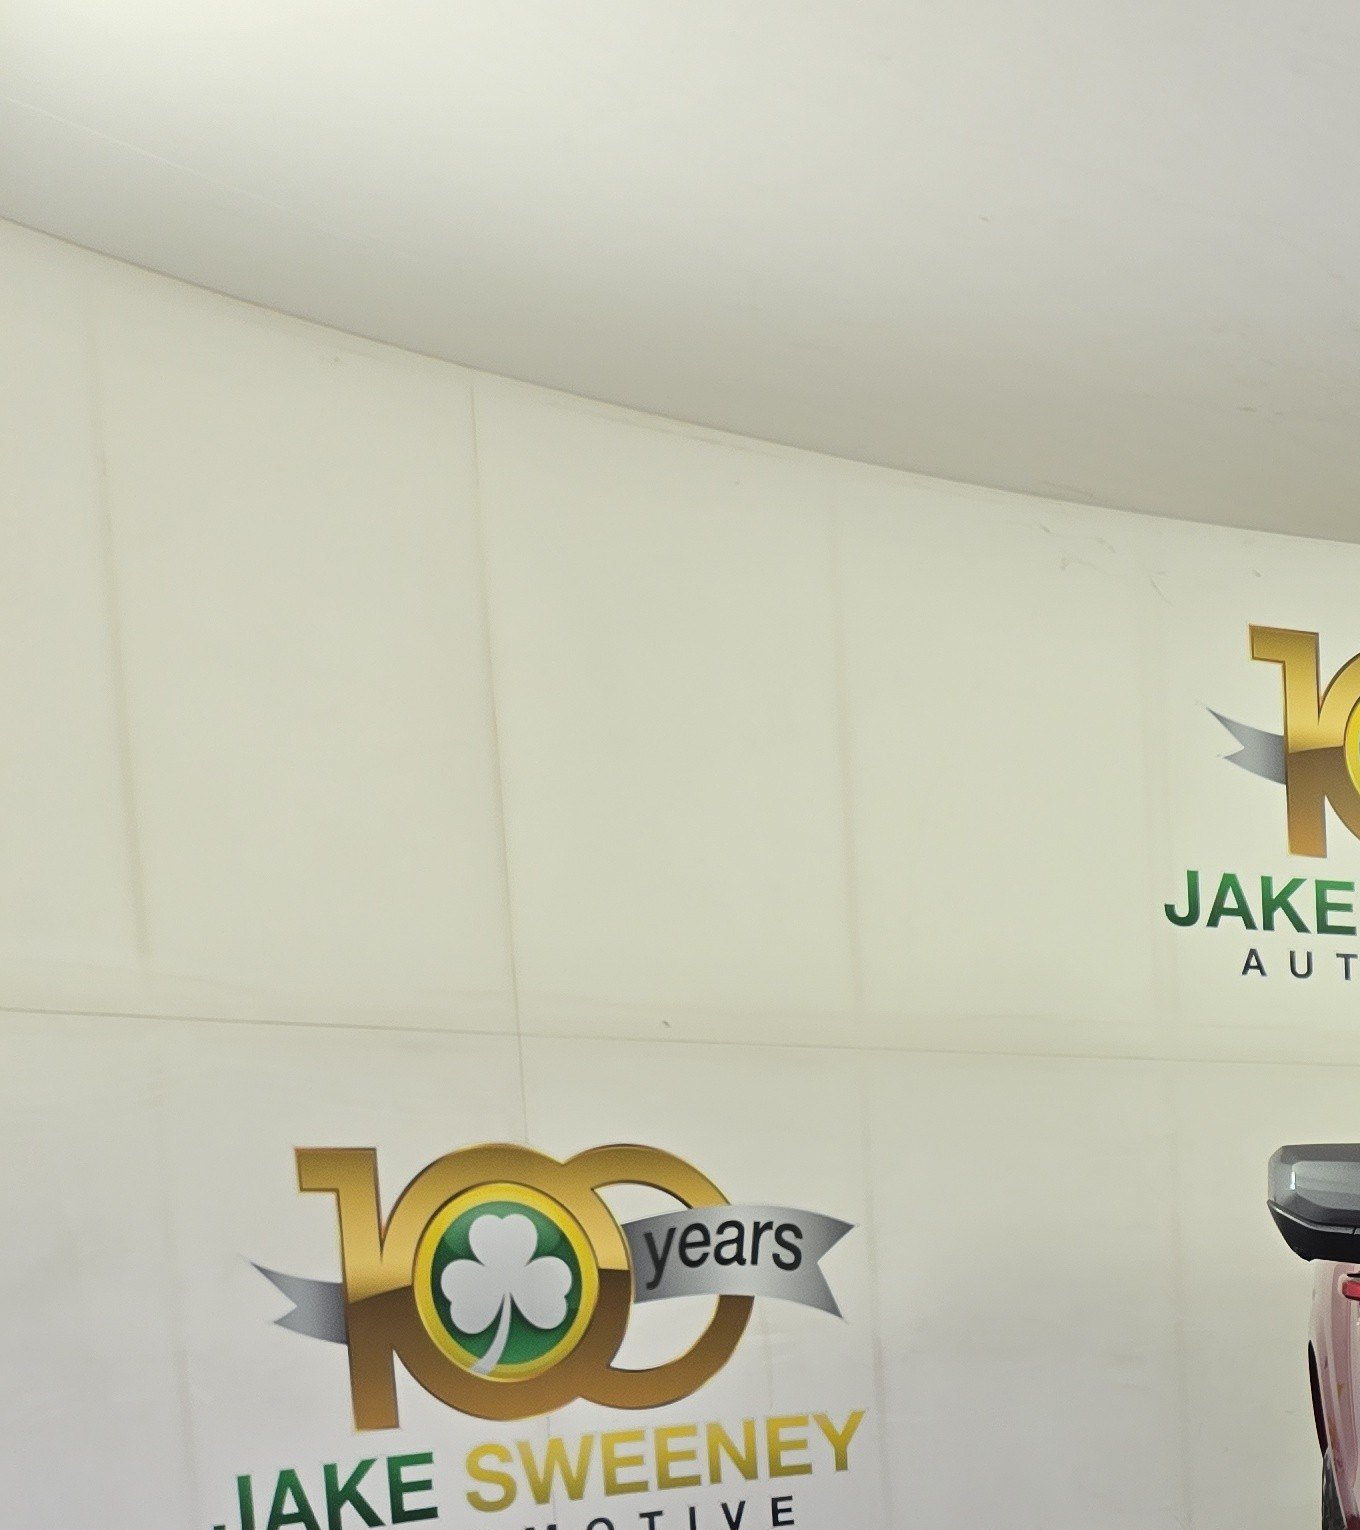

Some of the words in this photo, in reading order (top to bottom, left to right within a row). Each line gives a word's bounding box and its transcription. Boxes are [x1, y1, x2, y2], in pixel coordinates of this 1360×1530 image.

[1164, 869, 1356, 935] JAKE
[294, 1143, 756, 1431] 100
[643, 1218, 805, 1291] years
[464, 1409, 867, 1513] SWEENEY
